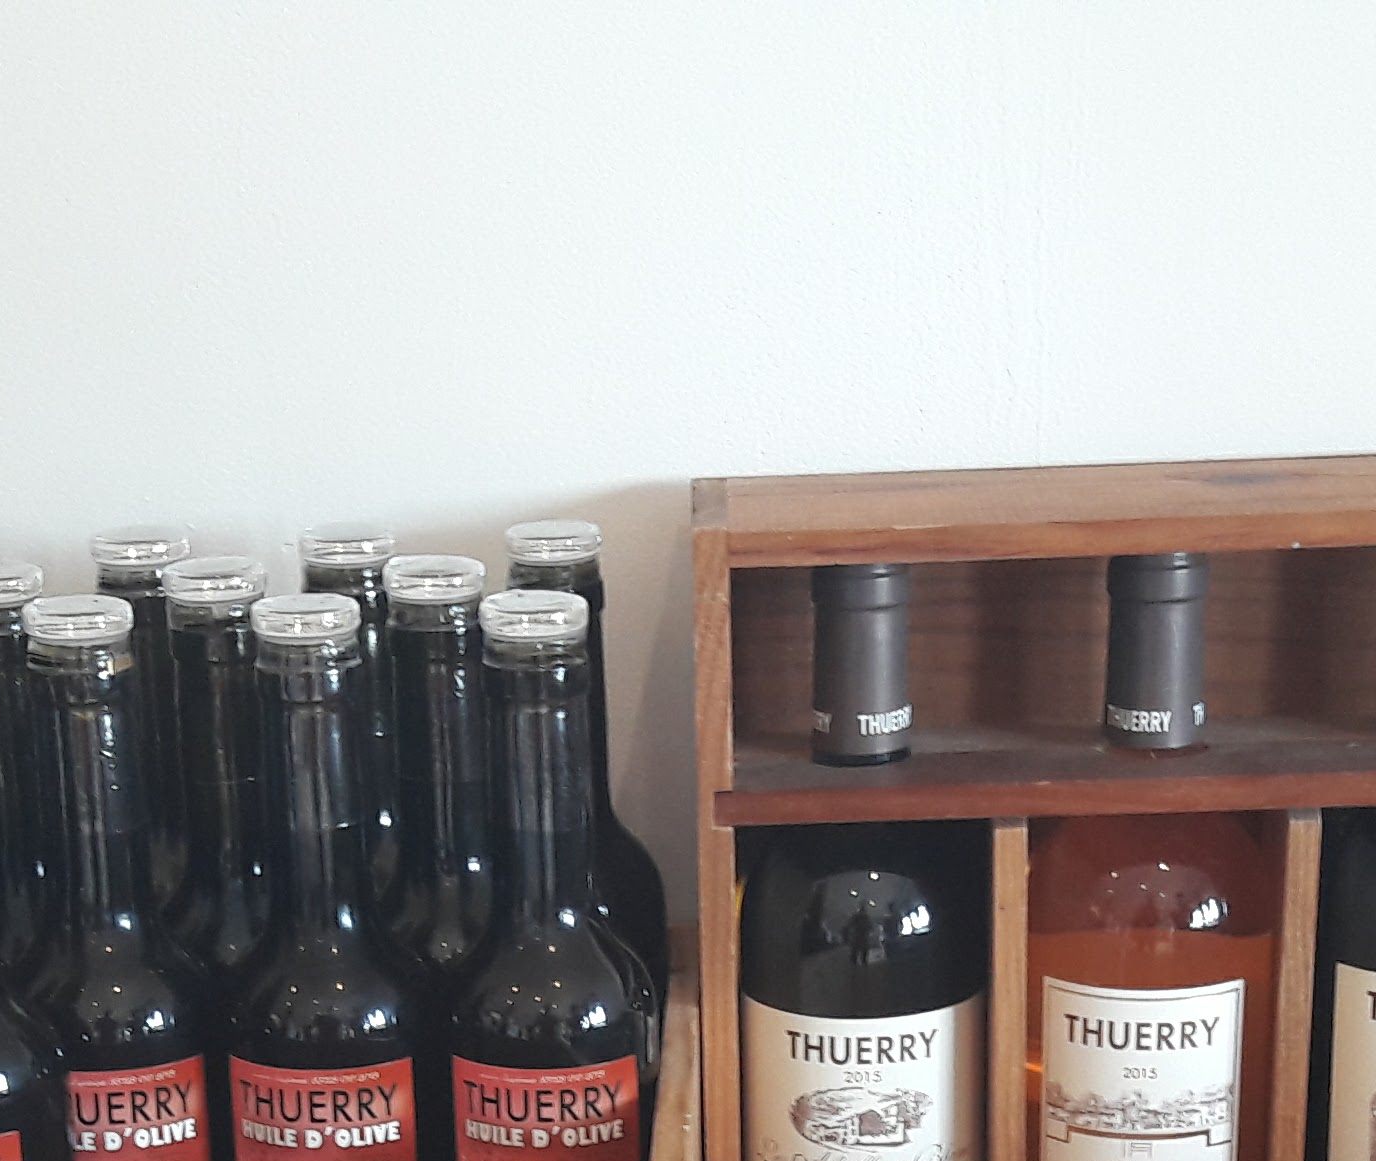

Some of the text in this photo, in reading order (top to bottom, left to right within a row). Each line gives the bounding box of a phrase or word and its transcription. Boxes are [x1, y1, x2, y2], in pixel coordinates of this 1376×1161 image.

[786, 1028, 940, 1065] THUERRY
[1063, 1013, 1221, 1051] THUERRY
[70, 1081, 191, 1126] UERRY
[240, 1080, 398, 1123] THUERRY
[464, 1080, 623, 1123] THUERRY
[103, 1117, 197, 1152] D'OLIVE
[242, 1120, 401, 1149] HUILE D'OLIVE
[465, 1119, 625, 1148] HUILE D'OLIVE
